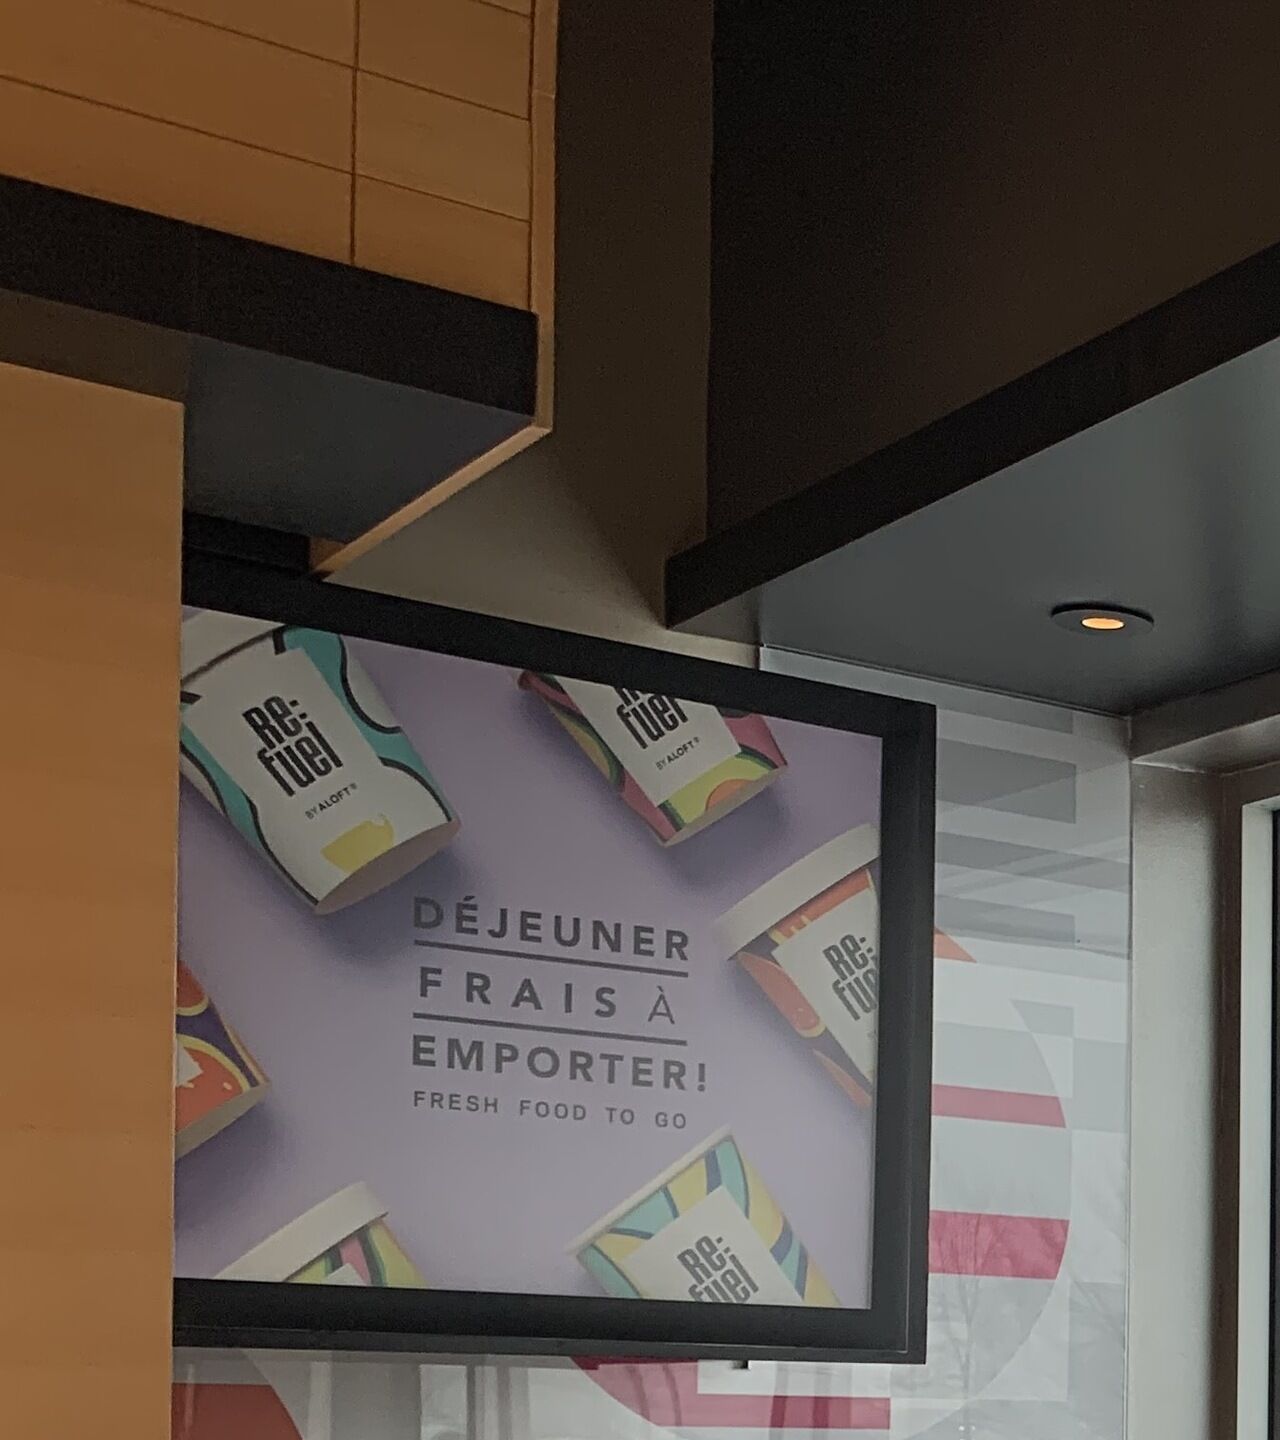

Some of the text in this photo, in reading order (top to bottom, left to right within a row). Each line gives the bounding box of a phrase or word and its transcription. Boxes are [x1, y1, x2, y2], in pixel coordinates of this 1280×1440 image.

[256, 721, 343, 797] fuel
[655, 759, 667, 770] BY
[305, 807, 319, 820] BY
[413, 895, 689, 961] DÉJEUNER
[419, 966, 675, 1025] FRAIS À
[412, 1034, 706, 1092] EMPORTER!
[413, 1090, 686, 1129] FRESH FOOD TO GO
